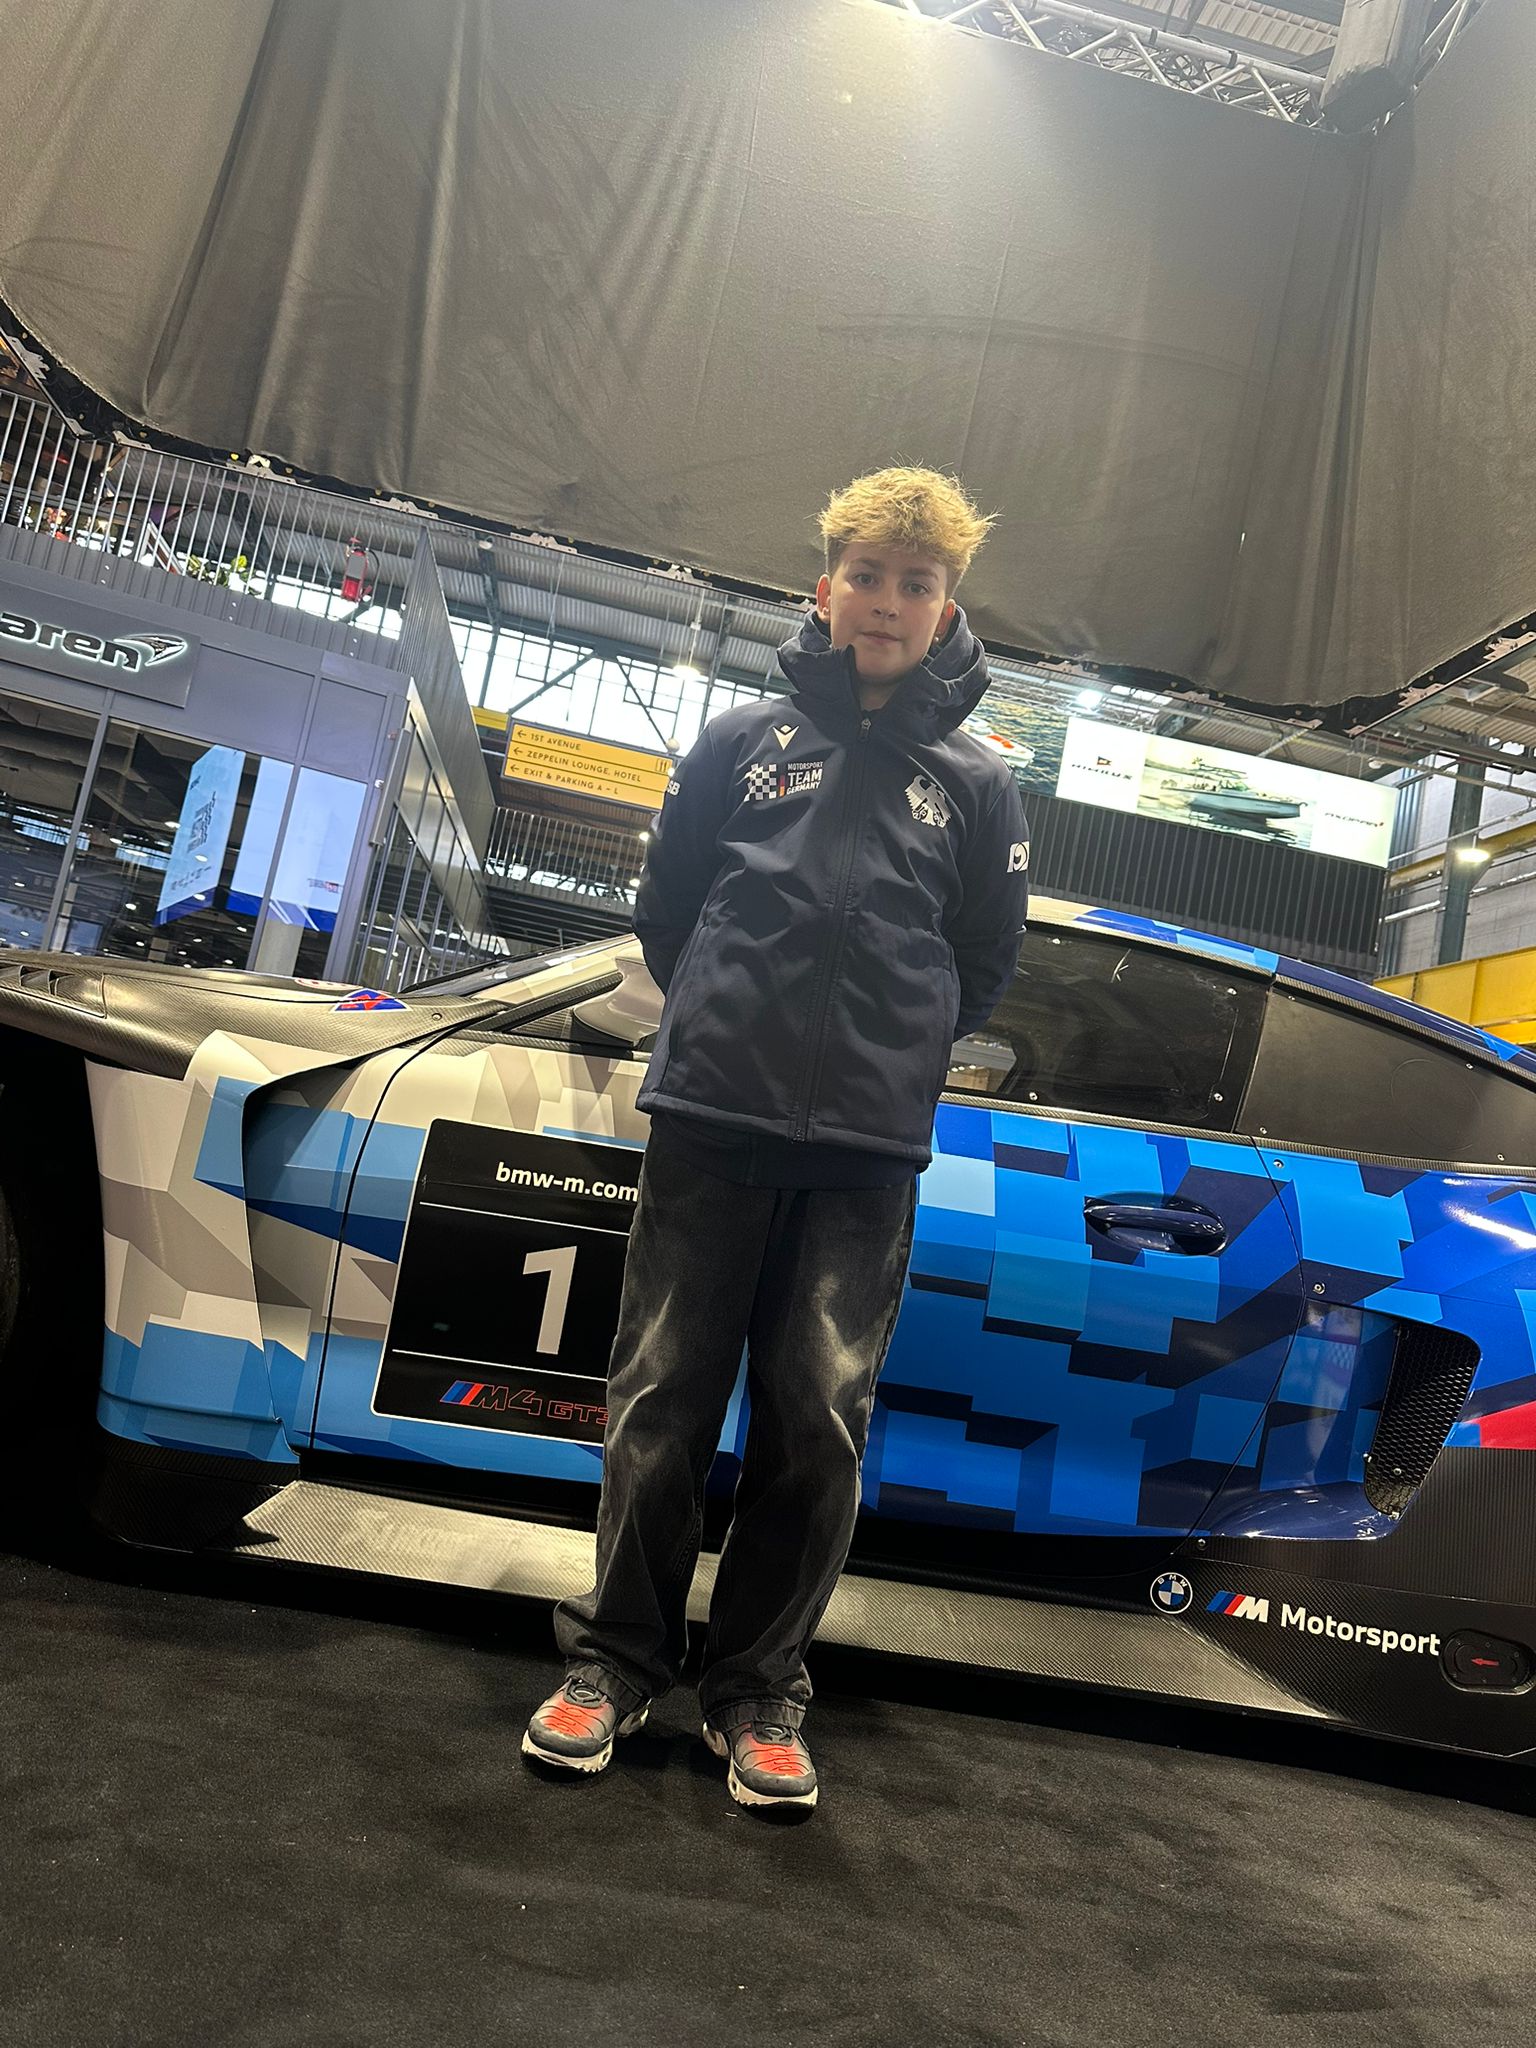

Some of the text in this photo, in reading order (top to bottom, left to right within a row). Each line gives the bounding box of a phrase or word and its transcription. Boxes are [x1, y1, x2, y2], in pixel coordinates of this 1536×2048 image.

[530, 733, 581, 750] 1ST AVENUE
[527, 750, 569, 766] ZEPPELIN
[614, 770, 641, 783] HOTEL
[788, 762, 823, 771] MOTORSPORT
[788, 769, 822, 786] TEAM
[523, 767, 543, 778] EXIT
[546, 771, 552, 780] &
[555, 774, 594, 790] PARKING
[597, 783, 603, 791] A
[613, 787, 619, 795] L
[787, 782, 820, 795] GERMANY
[495, 1161, 639, 1202] bmw-m.com
[523, 1246, 577, 1355] 1
[469, 1384, 543, 1416] M4
[1157, 1574, 1188, 1588] BMW
[1280, 1603, 1441, 1656] Motorsport
